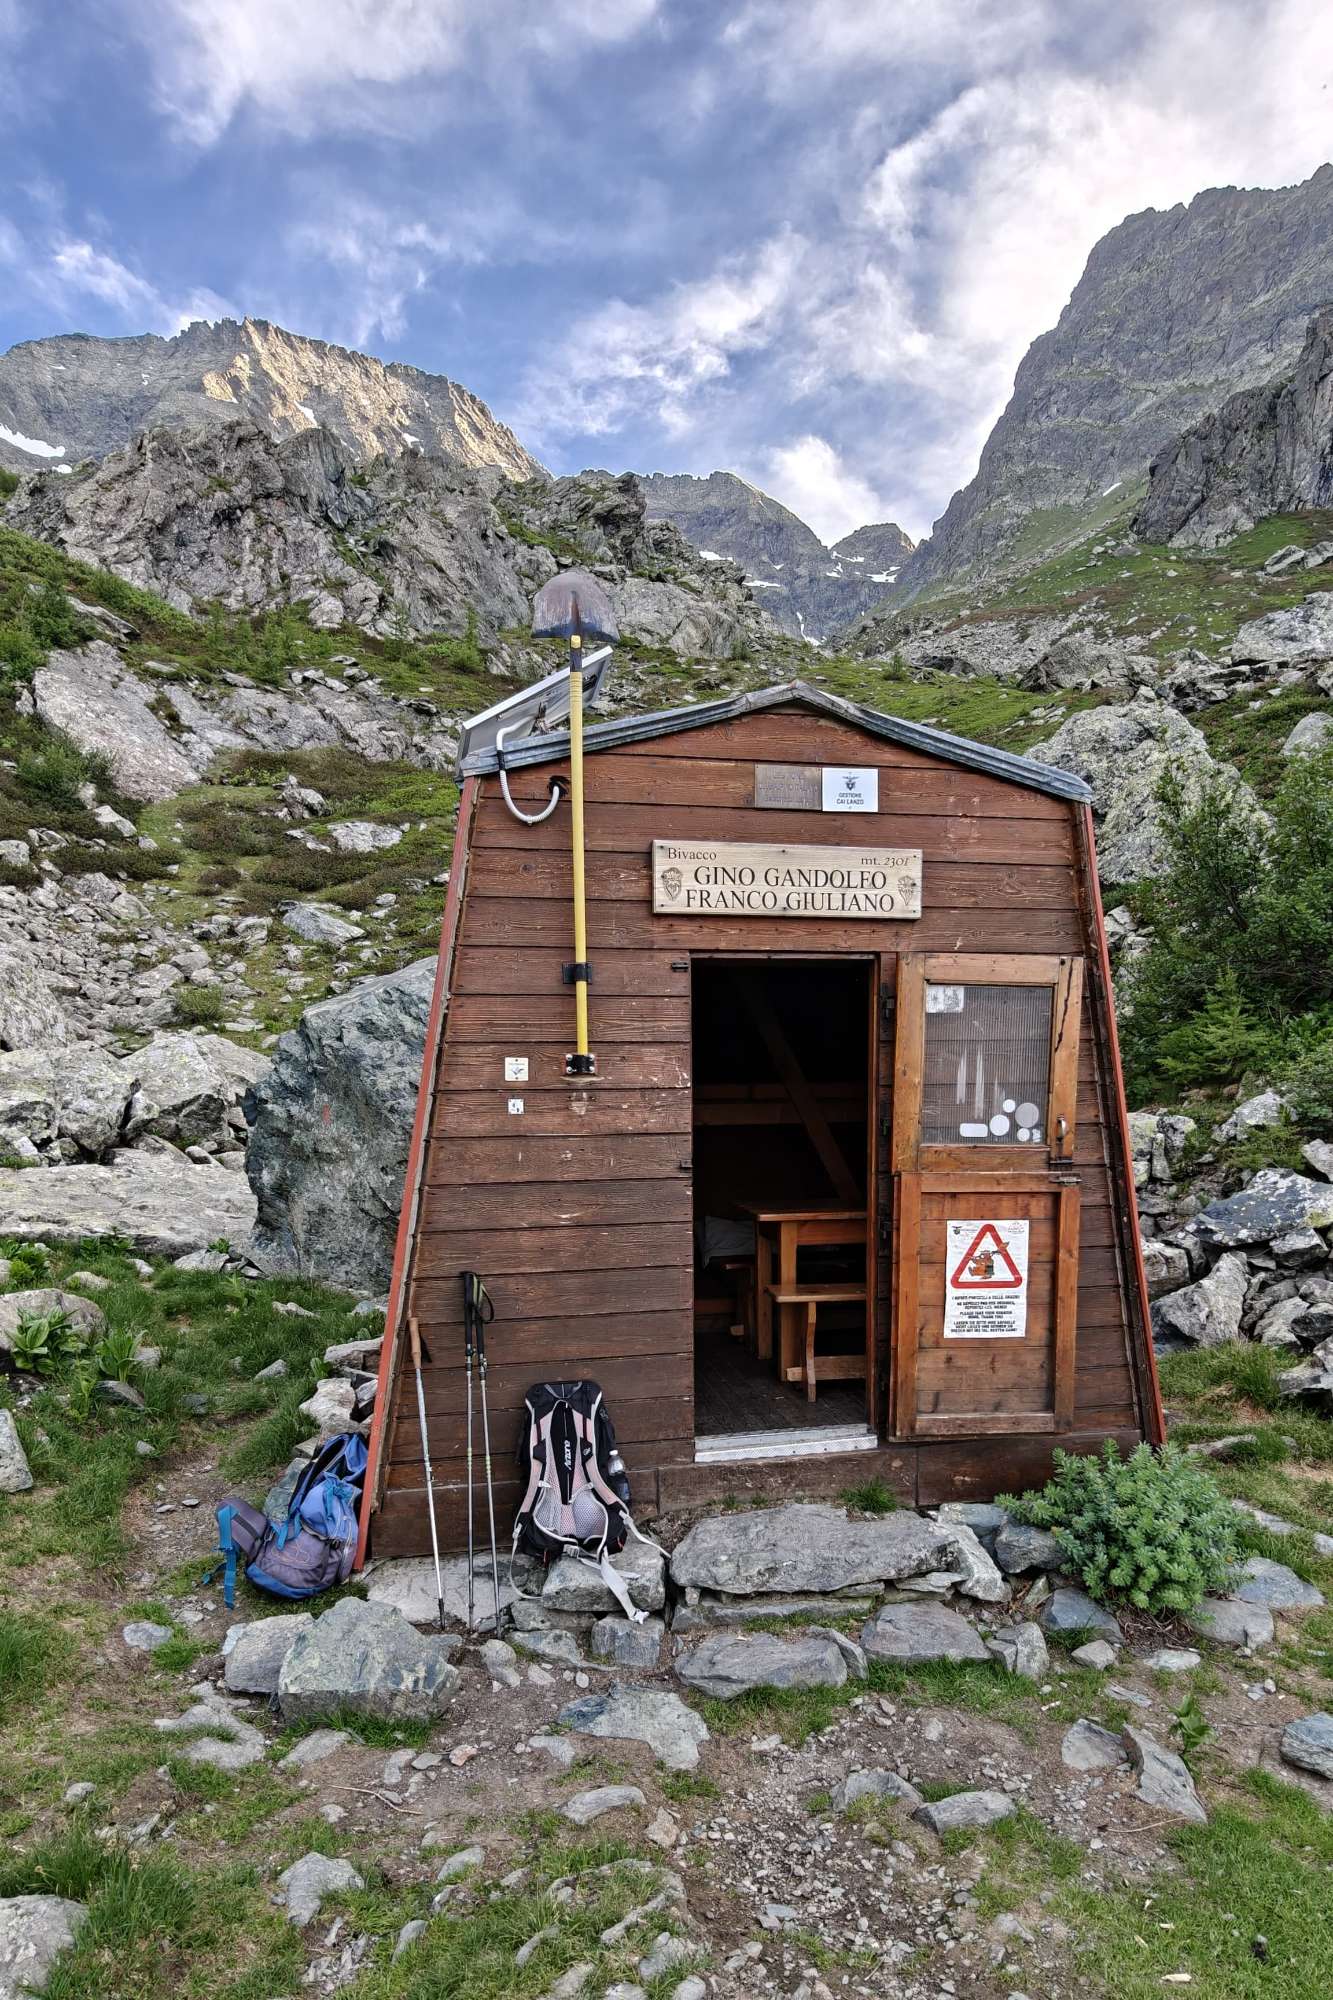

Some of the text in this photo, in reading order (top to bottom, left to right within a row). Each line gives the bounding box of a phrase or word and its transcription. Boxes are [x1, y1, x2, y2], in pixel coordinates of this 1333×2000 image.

[667, 846, 718, 861] Bivacco
[860, 856, 911, 869] mt. 2301
[693, 865, 888, 891] GINO GANDOLFO
[685, 888, 895, 914] FRANCO GIULIANO
